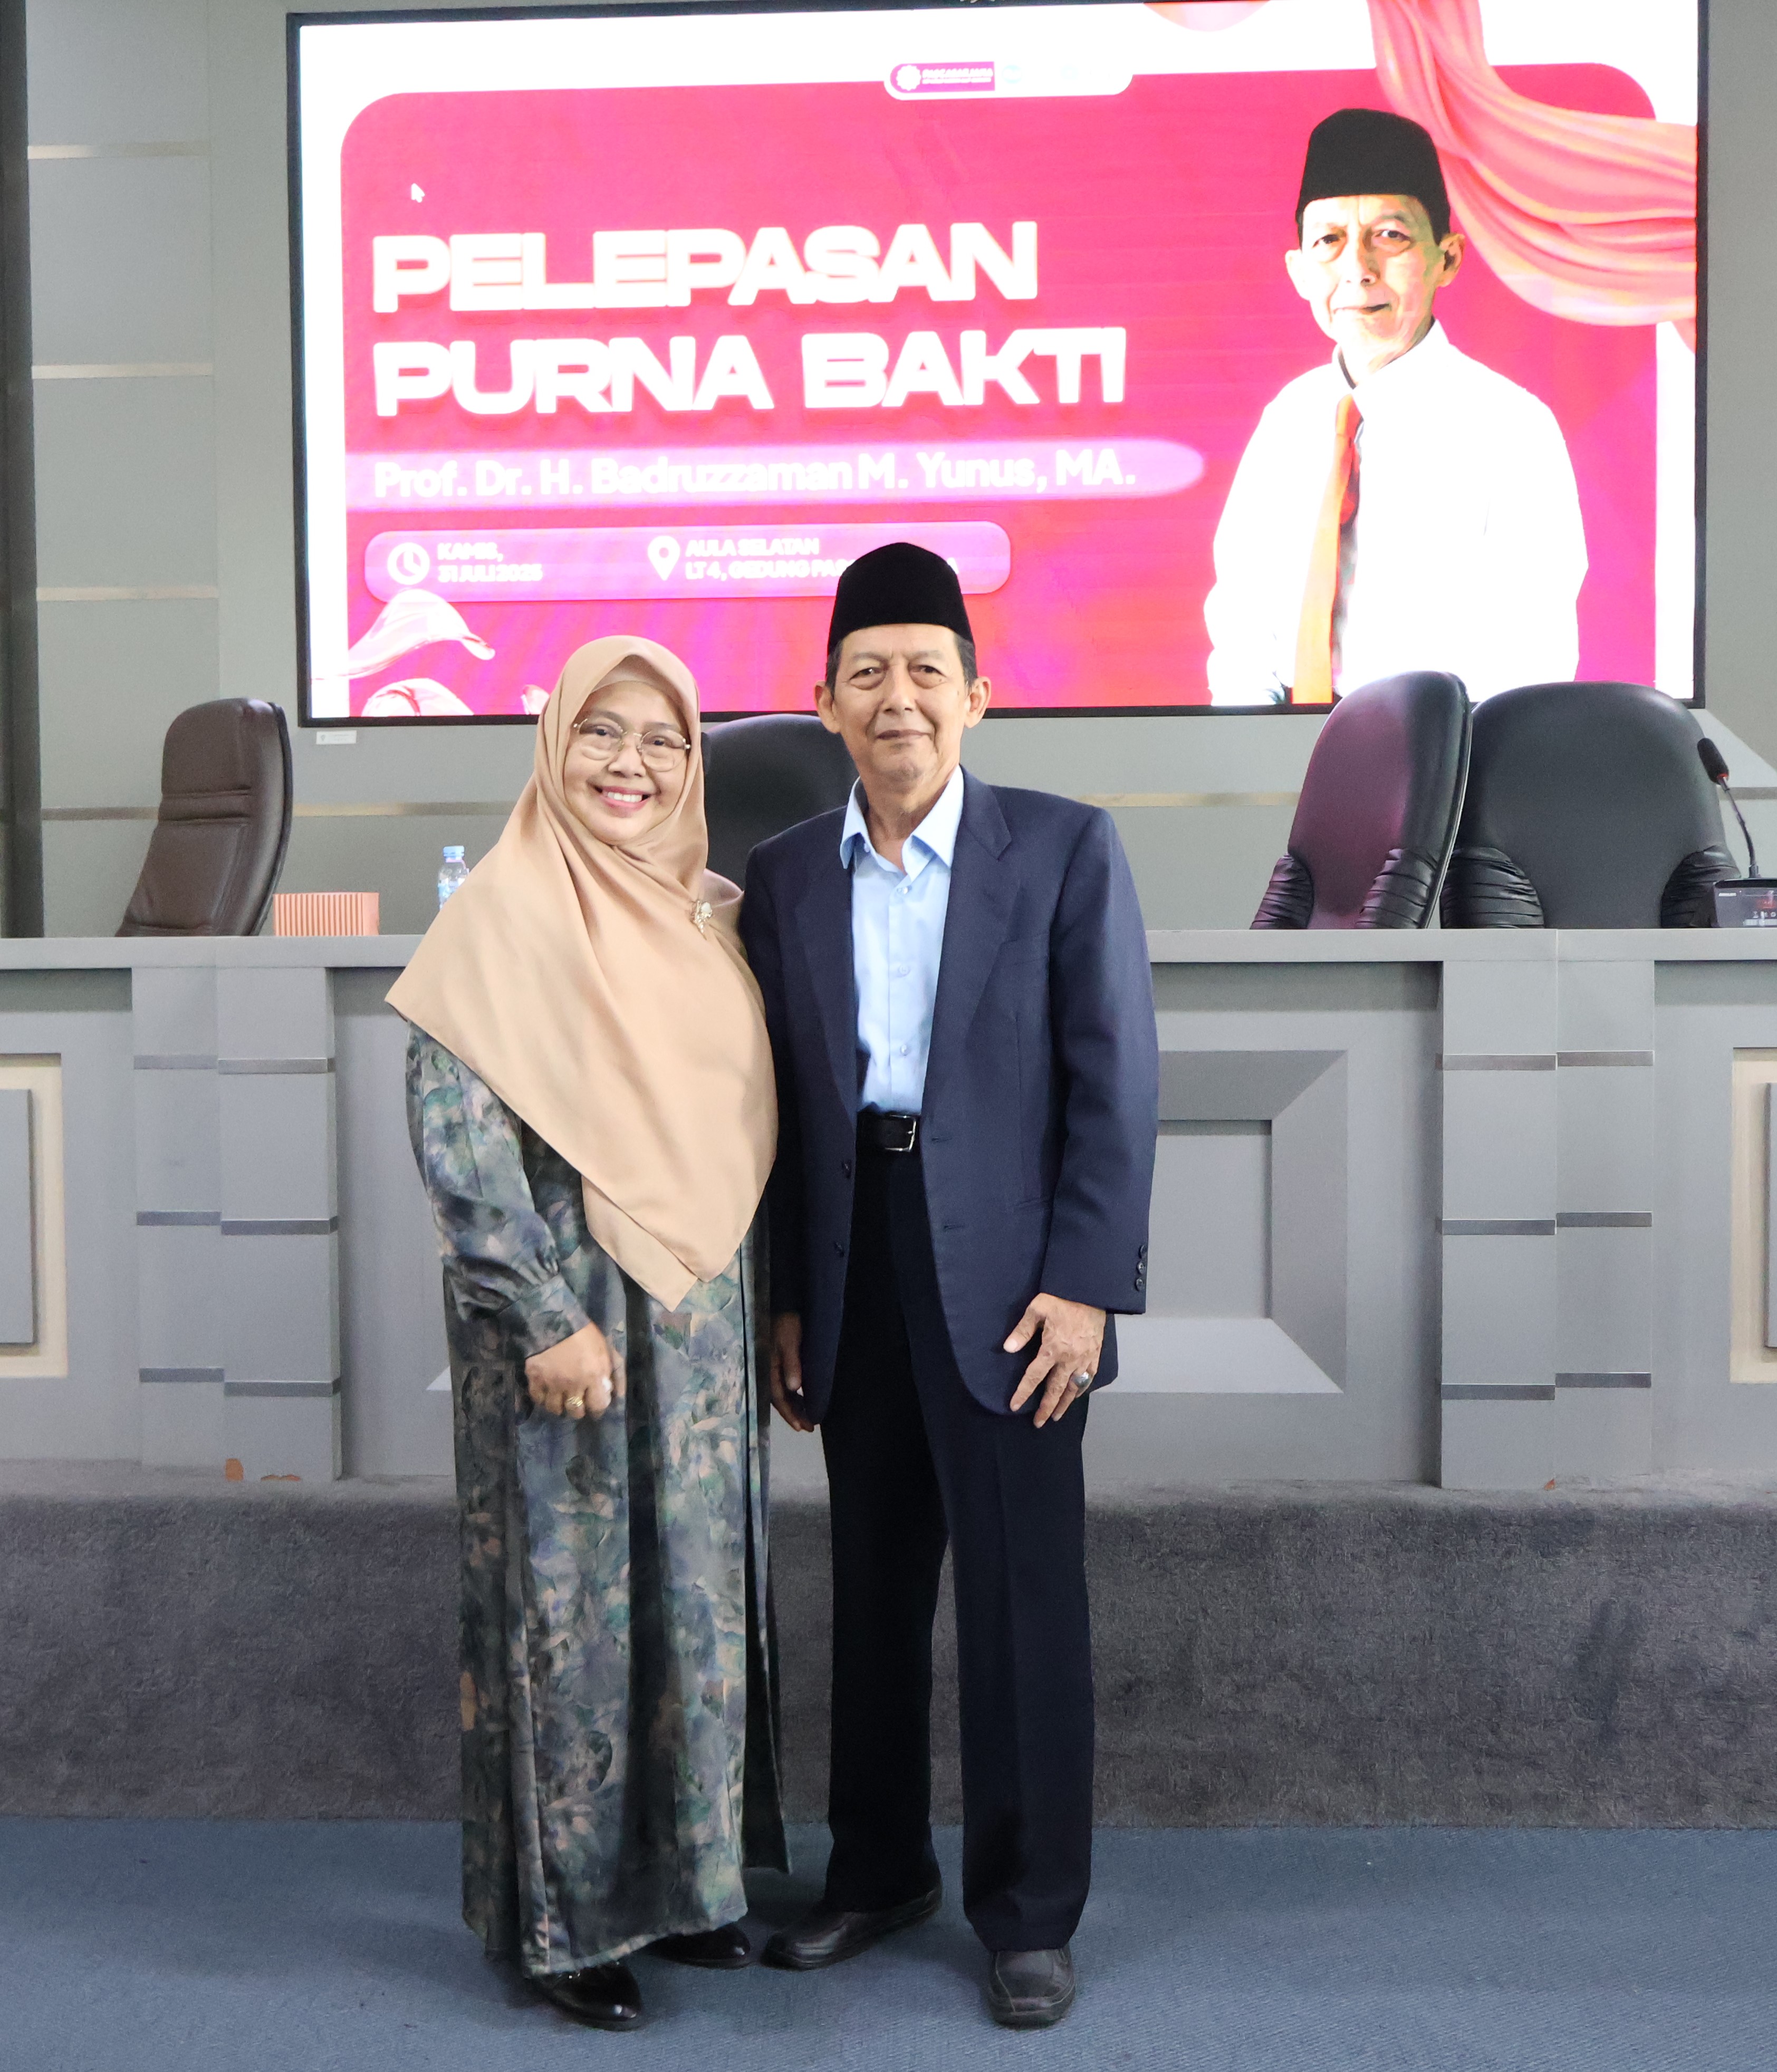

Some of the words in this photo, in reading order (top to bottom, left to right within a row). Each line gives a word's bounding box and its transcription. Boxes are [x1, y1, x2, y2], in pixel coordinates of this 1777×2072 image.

[372, 221, 1038, 313] PELEPASAN
[373, 335, 774, 416] PURNA
[801, 327, 1127, 408] BAKTI
[374, 461, 467, 497] Prof.
[475, 460, 532, 496] Dr.
[540, 458, 583, 495] H.
[591, 456, 852, 494] Badruzzaman
[858, 453, 908, 489] M.
[916, 452, 1047, 493] Yunus,
[1056, 448, 1135, 485] MA.
[685, 539, 737, 556] AULA
[737, 538, 819, 556] SELATAN
[685, 562, 707, 579] LT
[728, 560, 811, 579] GEDUNG
